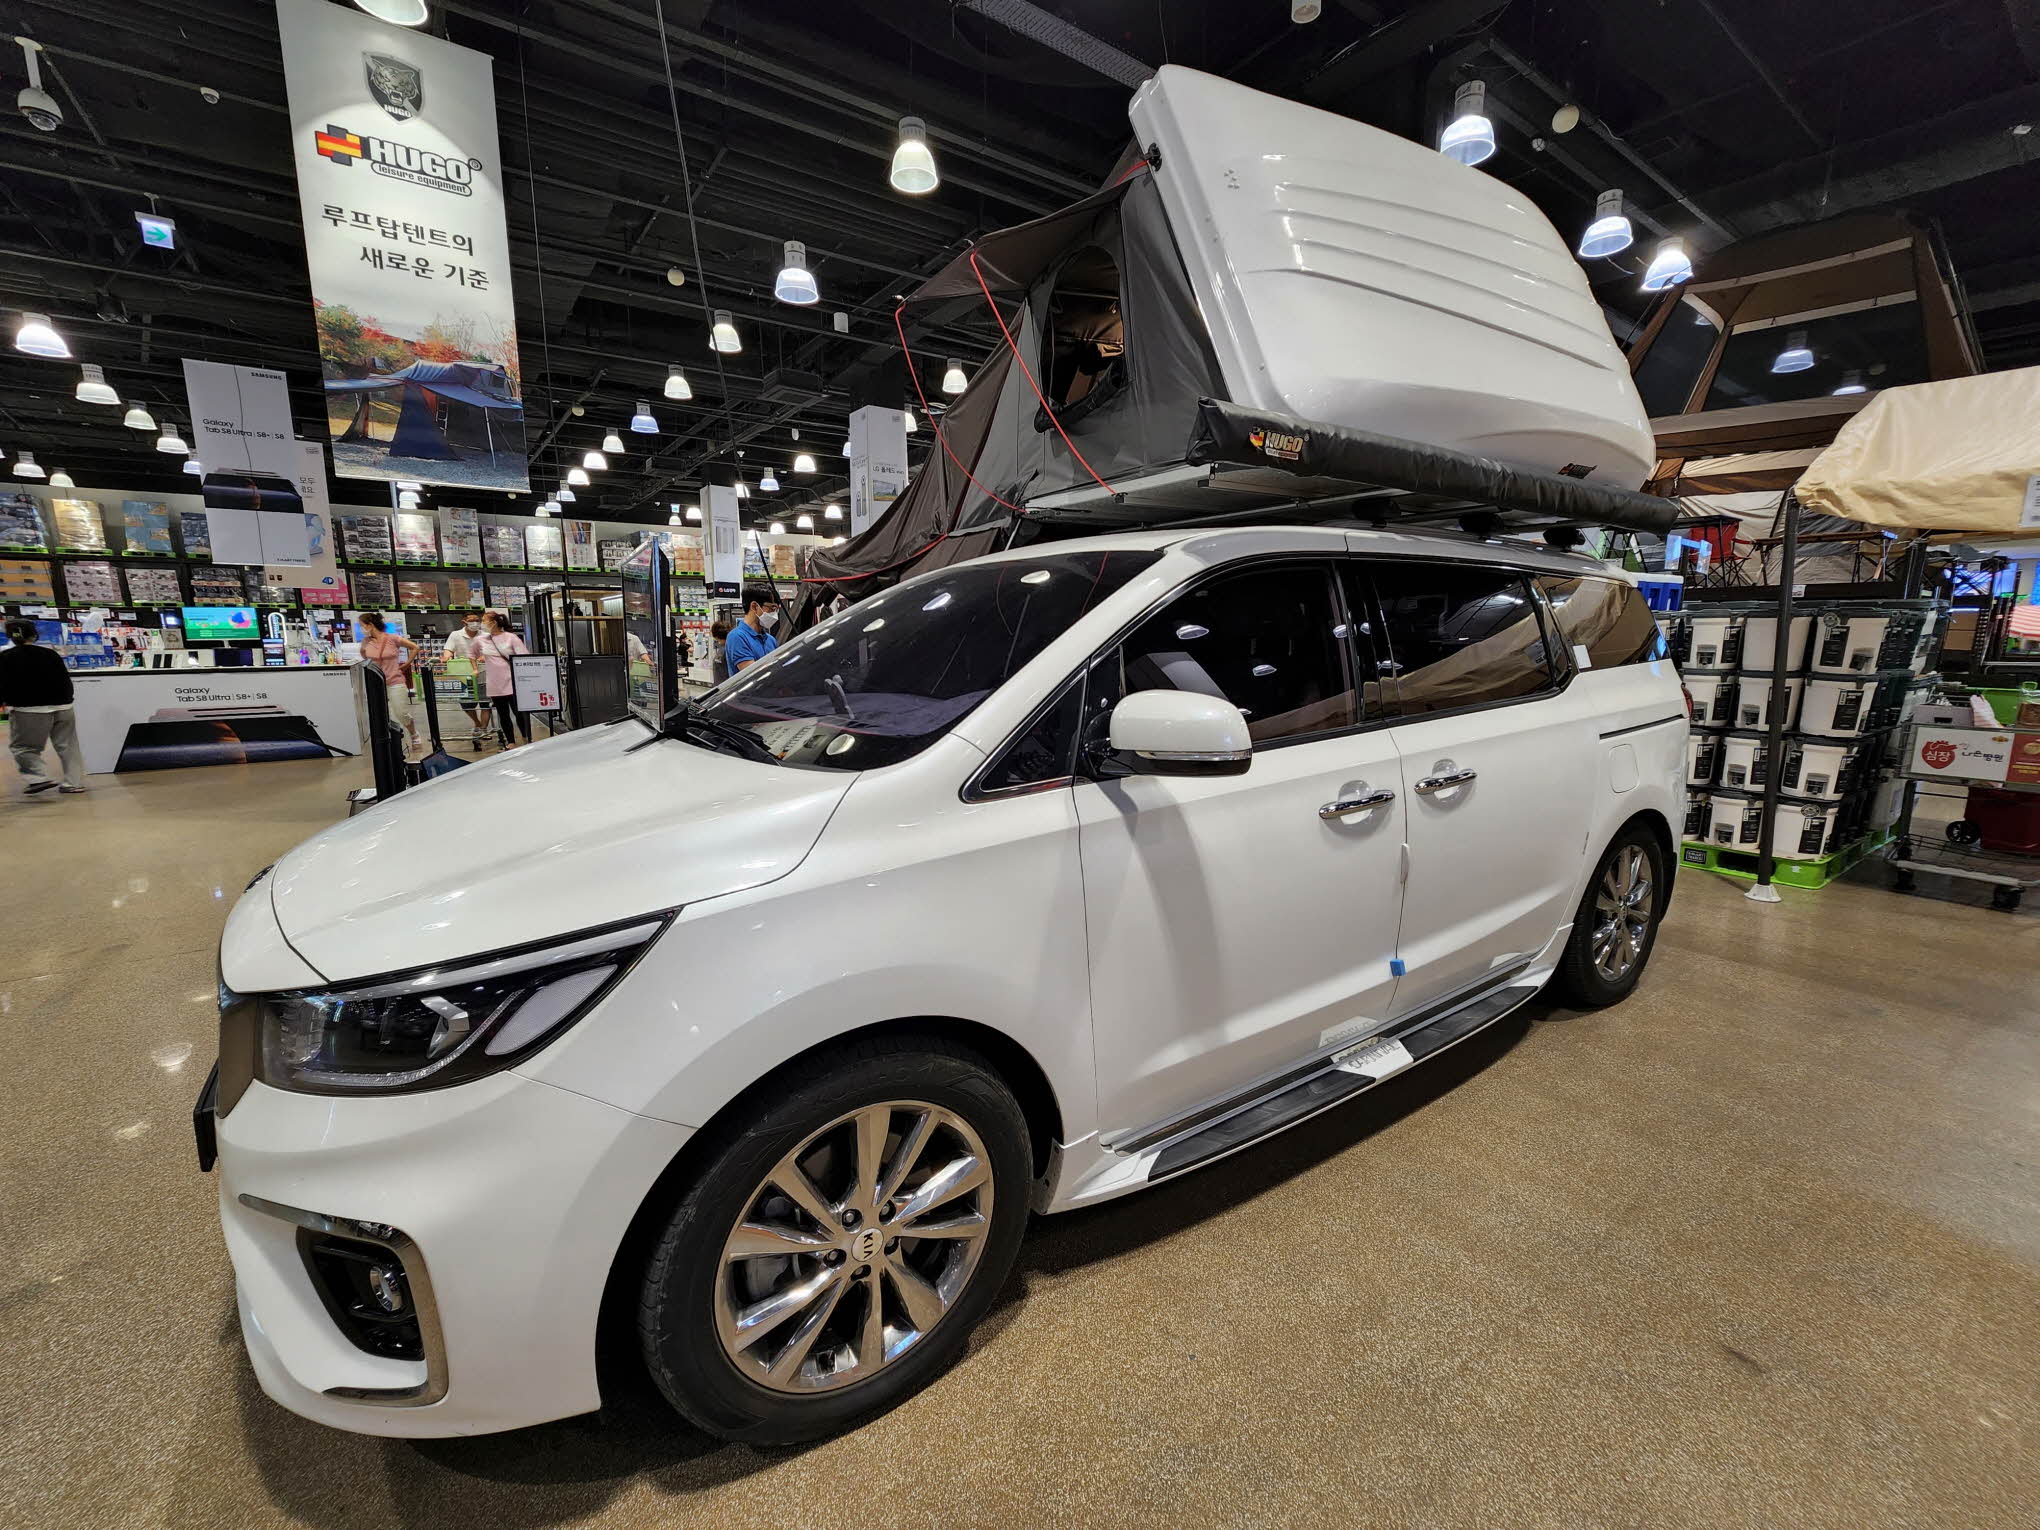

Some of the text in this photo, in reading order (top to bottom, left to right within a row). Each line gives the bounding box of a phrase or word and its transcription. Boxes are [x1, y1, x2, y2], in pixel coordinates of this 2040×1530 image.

[383, 104, 412, 118] HUGO
[368, 136, 472, 185] HUGO
[378, 164, 467, 194] leisure equipment
[321, 203, 474, 256] 루프탑텐트의
[360, 247, 490, 291] 새로운 기준
[250, 371, 282, 380] SAMSUNG
[202, 418, 234, 428] Galaxy
[204, 426, 221, 434] Tab
[221, 427, 232, 435] S8
[274, 432, 285, 440] S8
[1265, 431, 1304, 453] HUGO
[174, 687, 210, 695] Galaxy
[208, 693, 231, 702] Ultra
[236, 693, 251, 701] S8+
[1925, 750, 1952, 762] 심장
[864, 1232, 873, 1259] KIA
